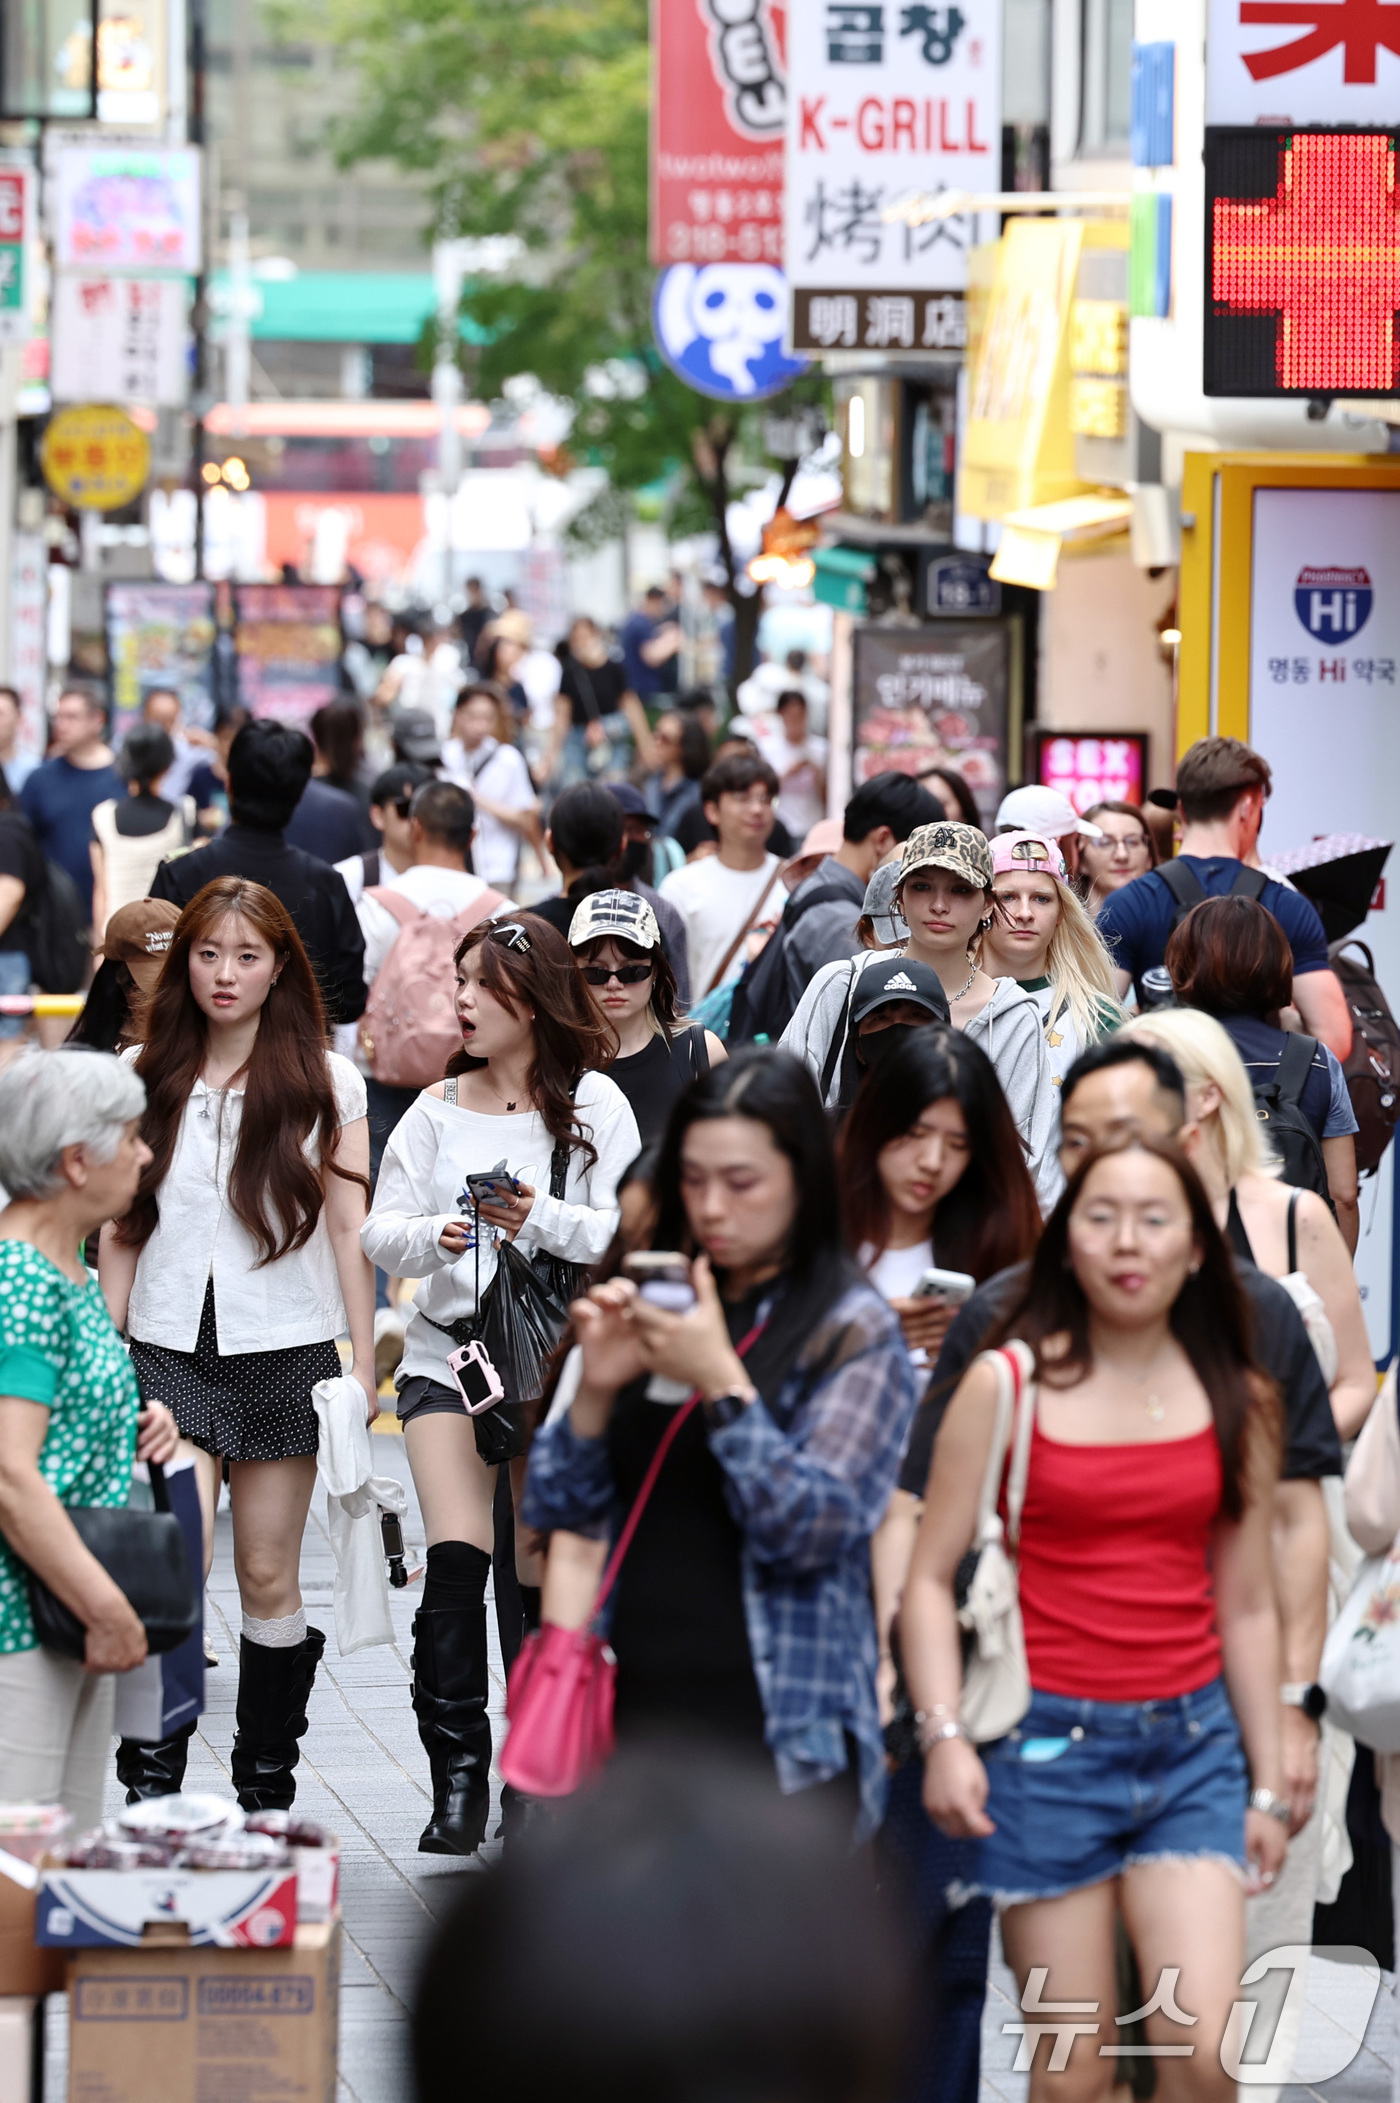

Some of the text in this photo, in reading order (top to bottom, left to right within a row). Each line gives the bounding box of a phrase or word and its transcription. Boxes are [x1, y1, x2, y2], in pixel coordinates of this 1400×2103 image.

[826, 5, 966, 65] 곱창
[799, 96, 989, 153] K-GRILL
[808, 295, 968, 348] 明洞店
[1310, 591, 1357, 632] Hi
[1268, 657, 1396, 686] 명동 Hi 약국
[1048, 739, 1130, 775] SEX
[883, 982, 918, 992] adidas
